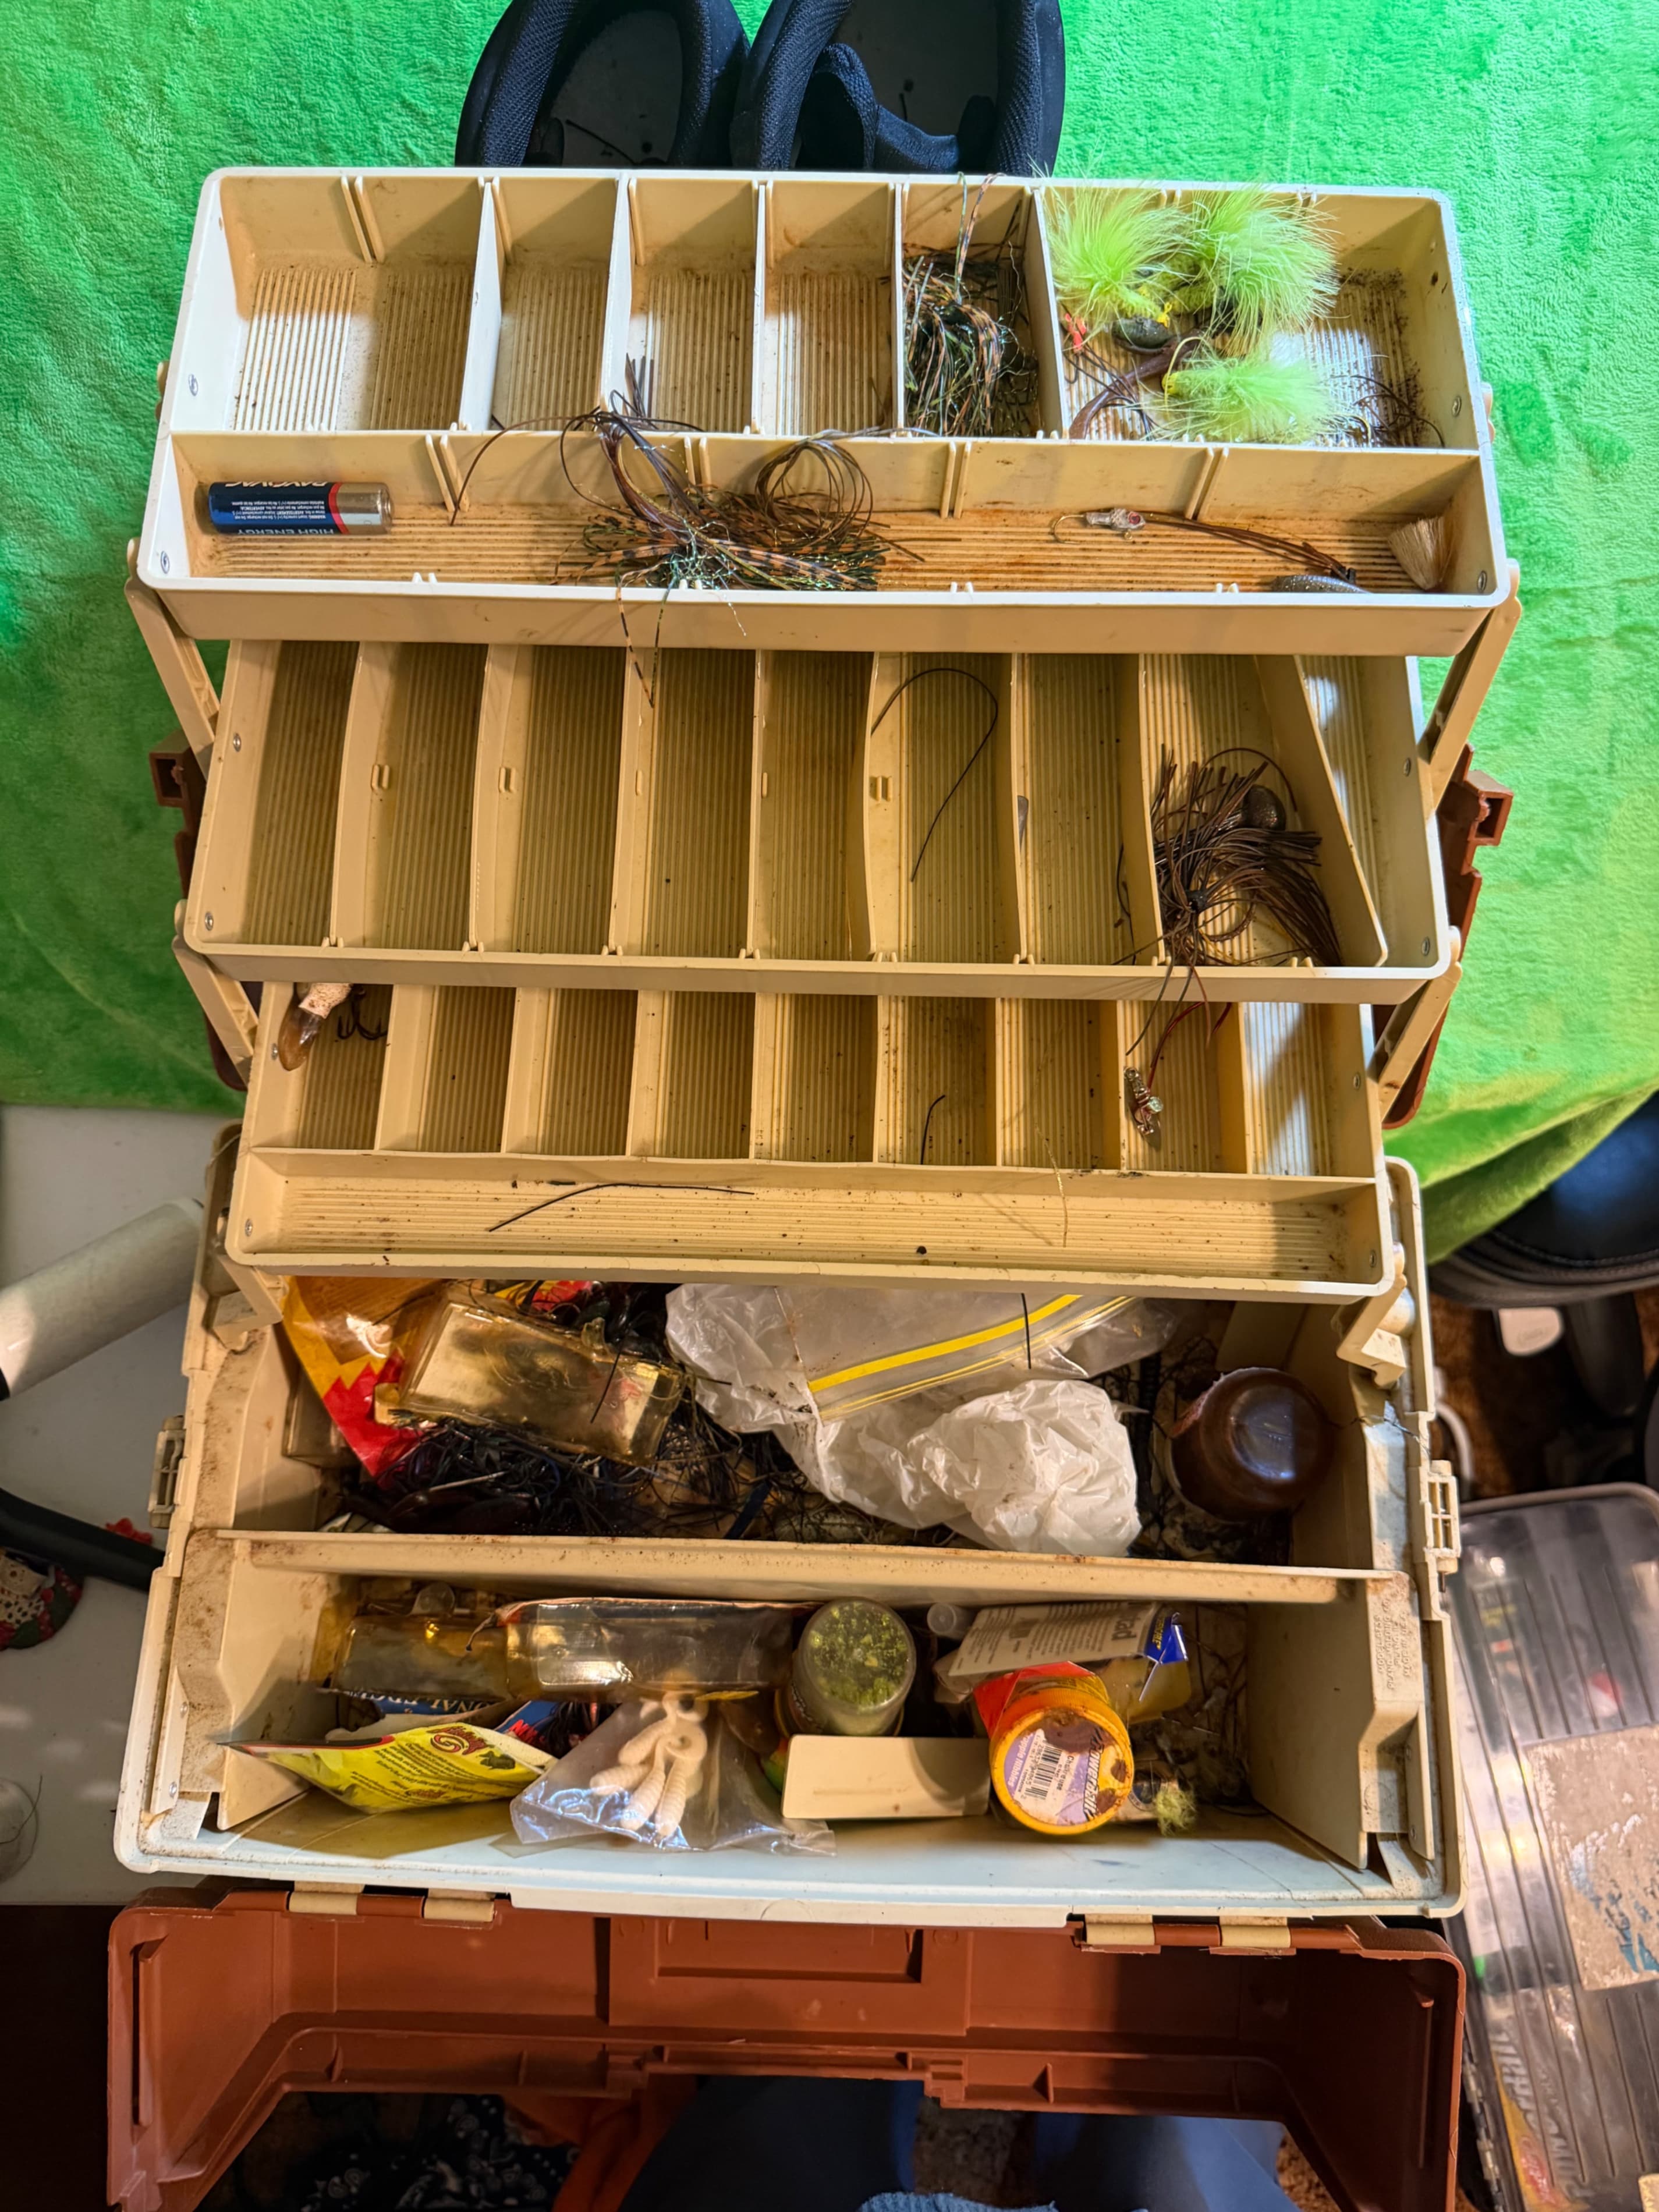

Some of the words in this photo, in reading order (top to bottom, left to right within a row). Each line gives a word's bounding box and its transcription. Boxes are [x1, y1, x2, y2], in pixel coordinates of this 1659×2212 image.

[1383, 1615, 1392, 1653] MOLDING
[1385, 1660, 1394, 1689] PLANO
[1083, 1740, 1105, 1814] PowerBait
